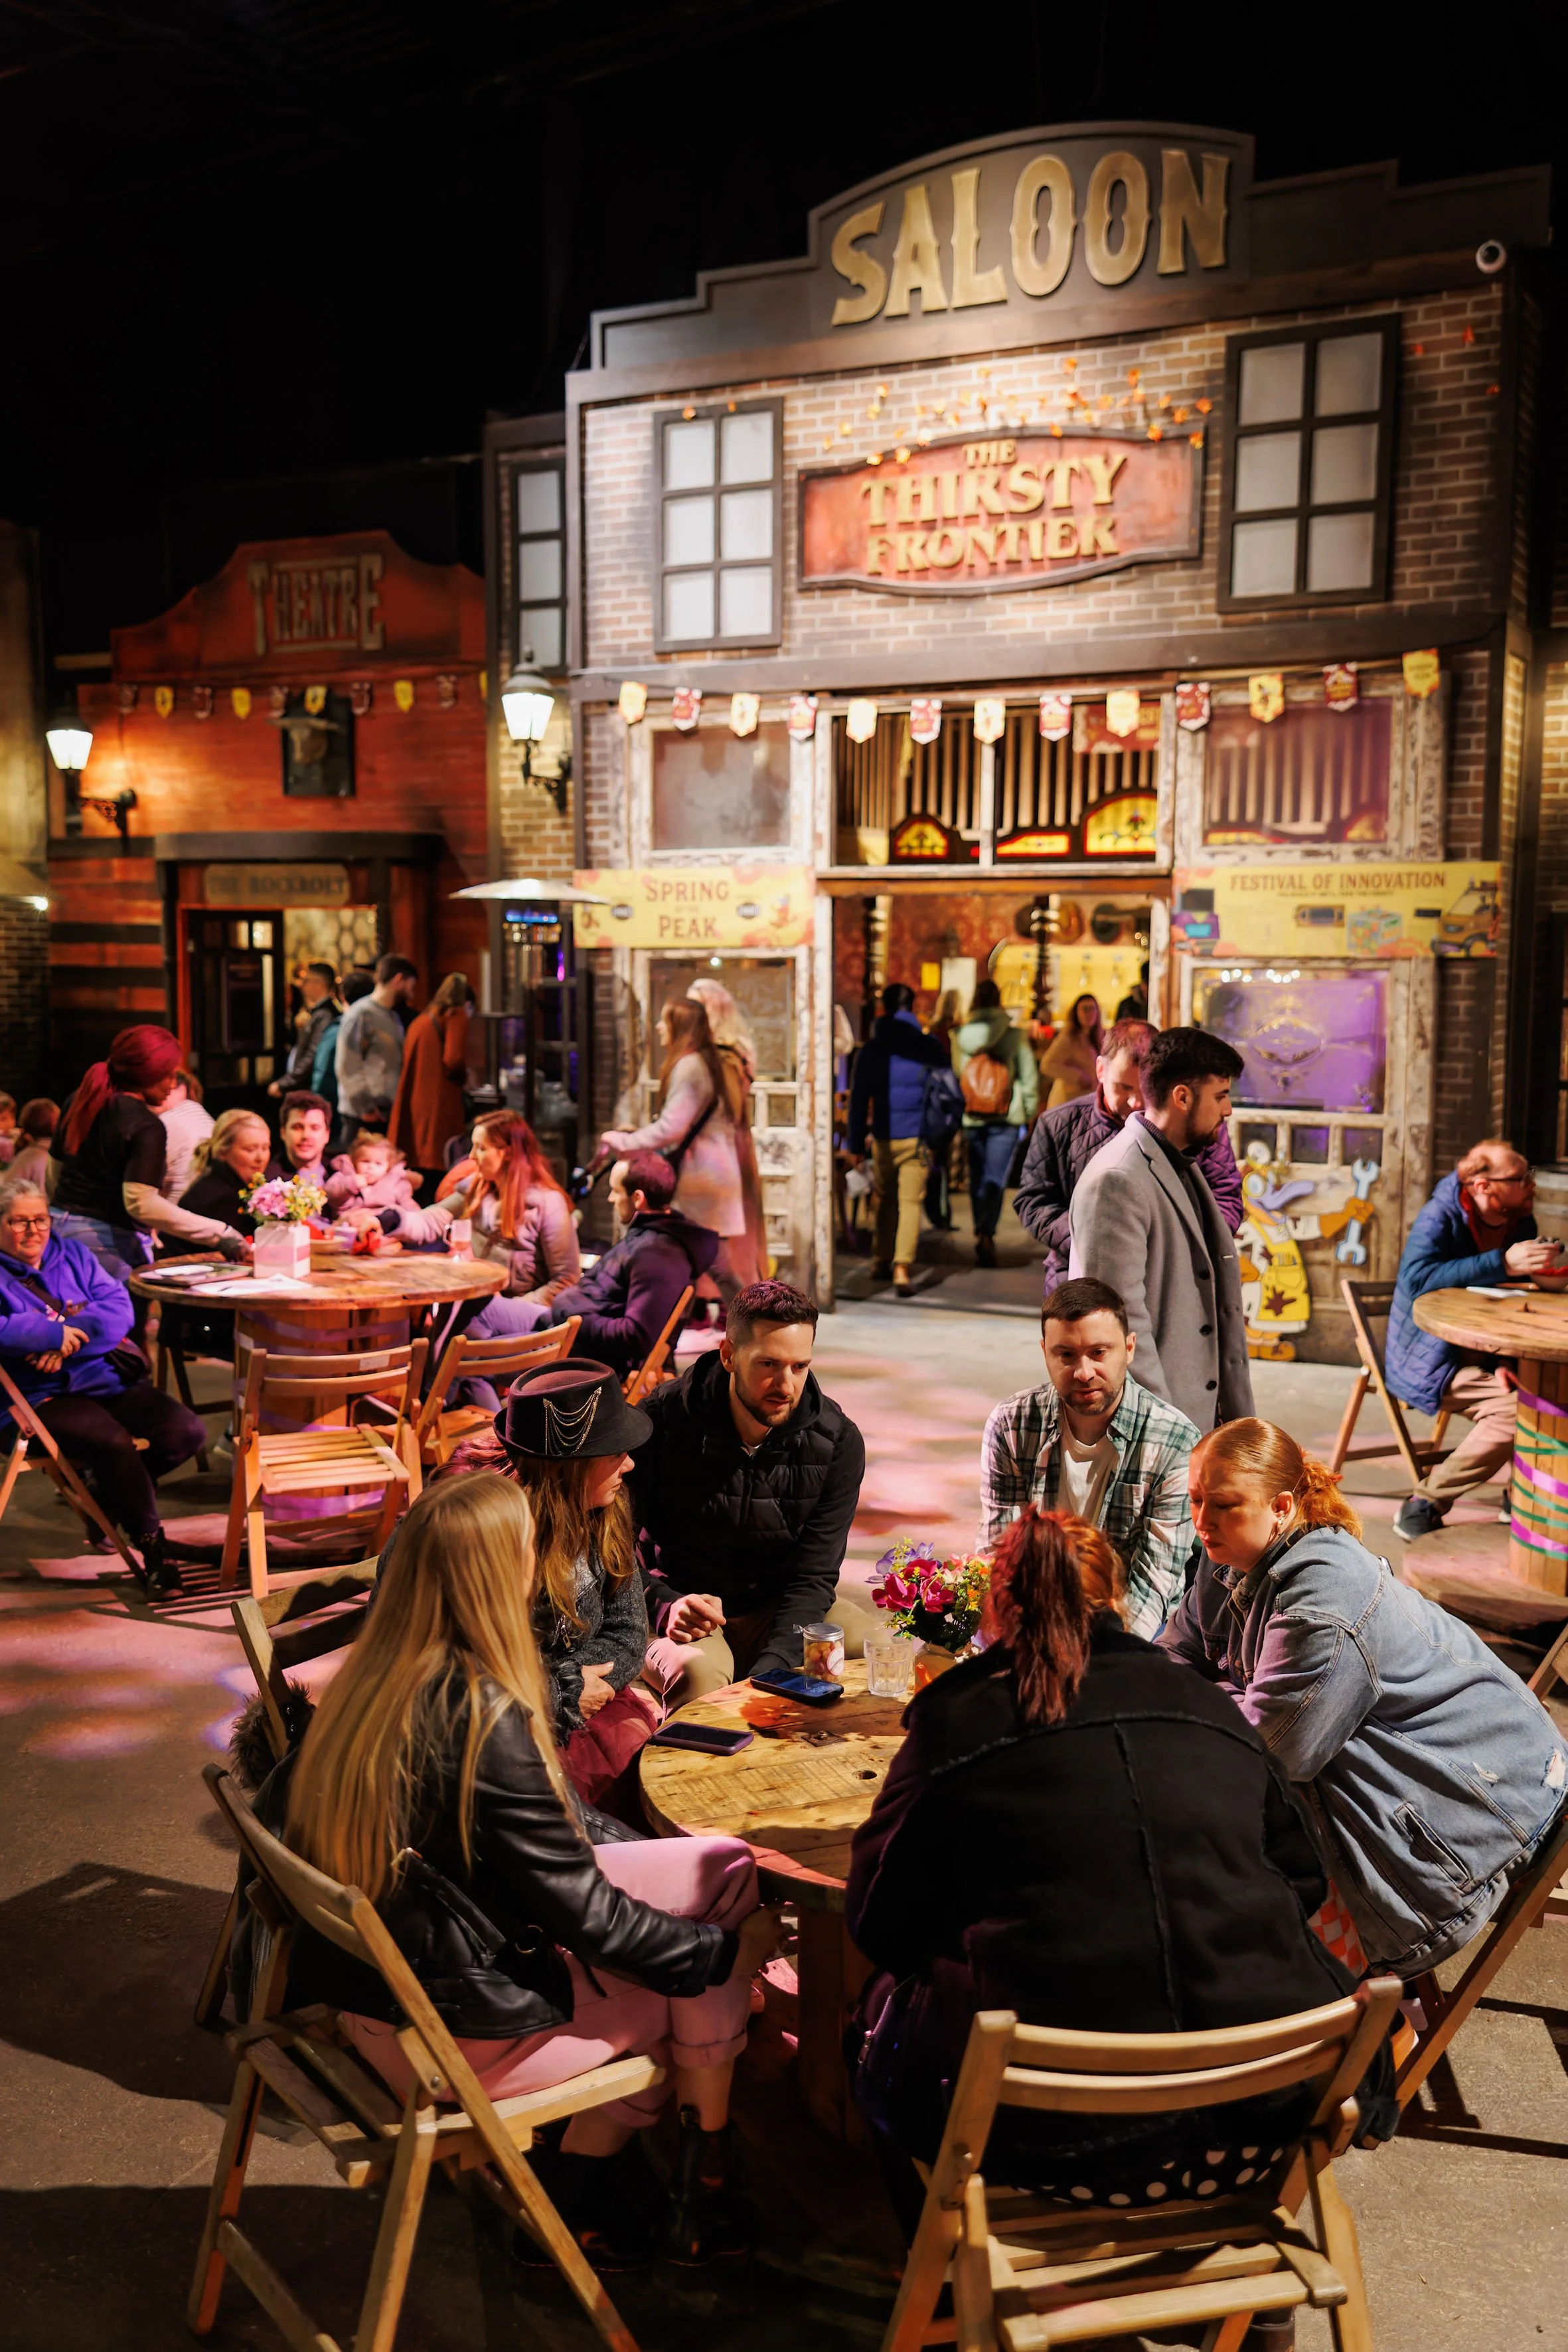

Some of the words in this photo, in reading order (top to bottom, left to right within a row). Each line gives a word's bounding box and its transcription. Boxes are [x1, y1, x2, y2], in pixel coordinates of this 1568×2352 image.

[830, 148, 1231, 326] SALOON
[962, 439, 1018, 468] THE
[861, 453, 1129, 527] THIRSTY
[866, 515, 1120, 575] FRONTIER
[248, 553, 384, 657] THEATRE
[646, 879, 730, 902] SPRING
[1230, 873, 1307, 892] FESTIVAL
[1312, 873, 1335, 890] OF
[1340, 871, 1447, 889] INNOVATION
[659, 915, 718, 939] PEAK
